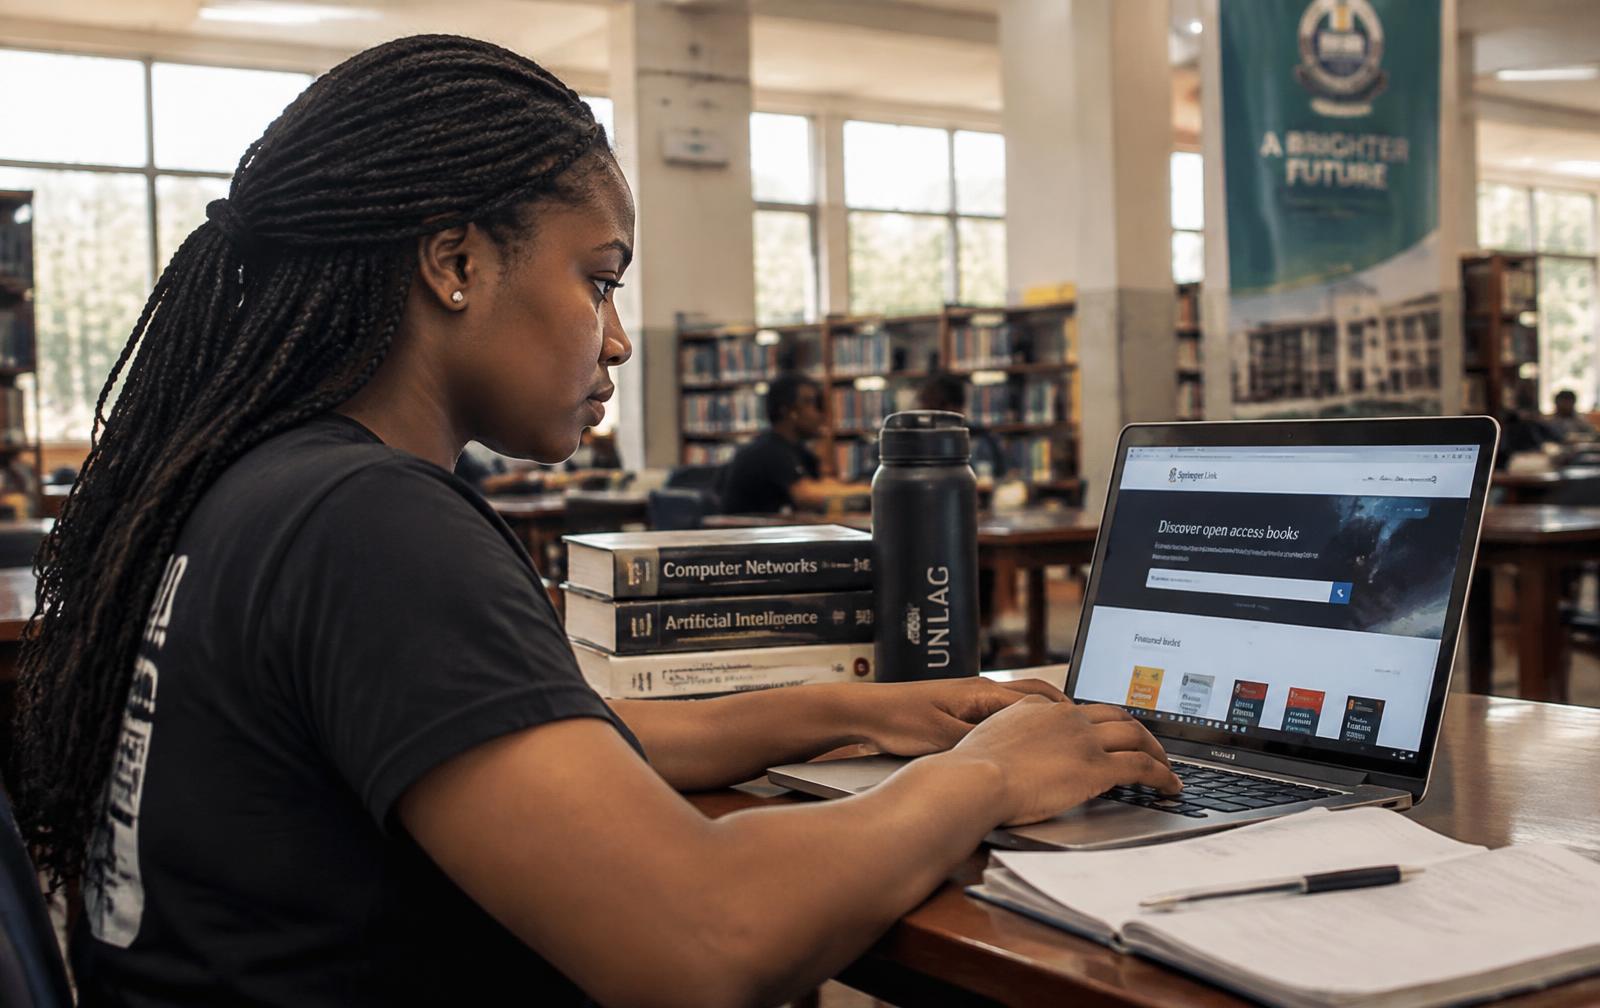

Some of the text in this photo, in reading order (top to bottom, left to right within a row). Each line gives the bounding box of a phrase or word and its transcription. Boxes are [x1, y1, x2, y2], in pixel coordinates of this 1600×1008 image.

[1260, 131, 1409, 163] A BRIGHTER
[1286, 159, 1388, 190] FUTURE
[1158, 520, 1300, 540] Discover open access books
[663, 561, 742, 580] Computer
[745, 558, 818, 575] Networks
[927, 566, 950, 668] UNLAG
